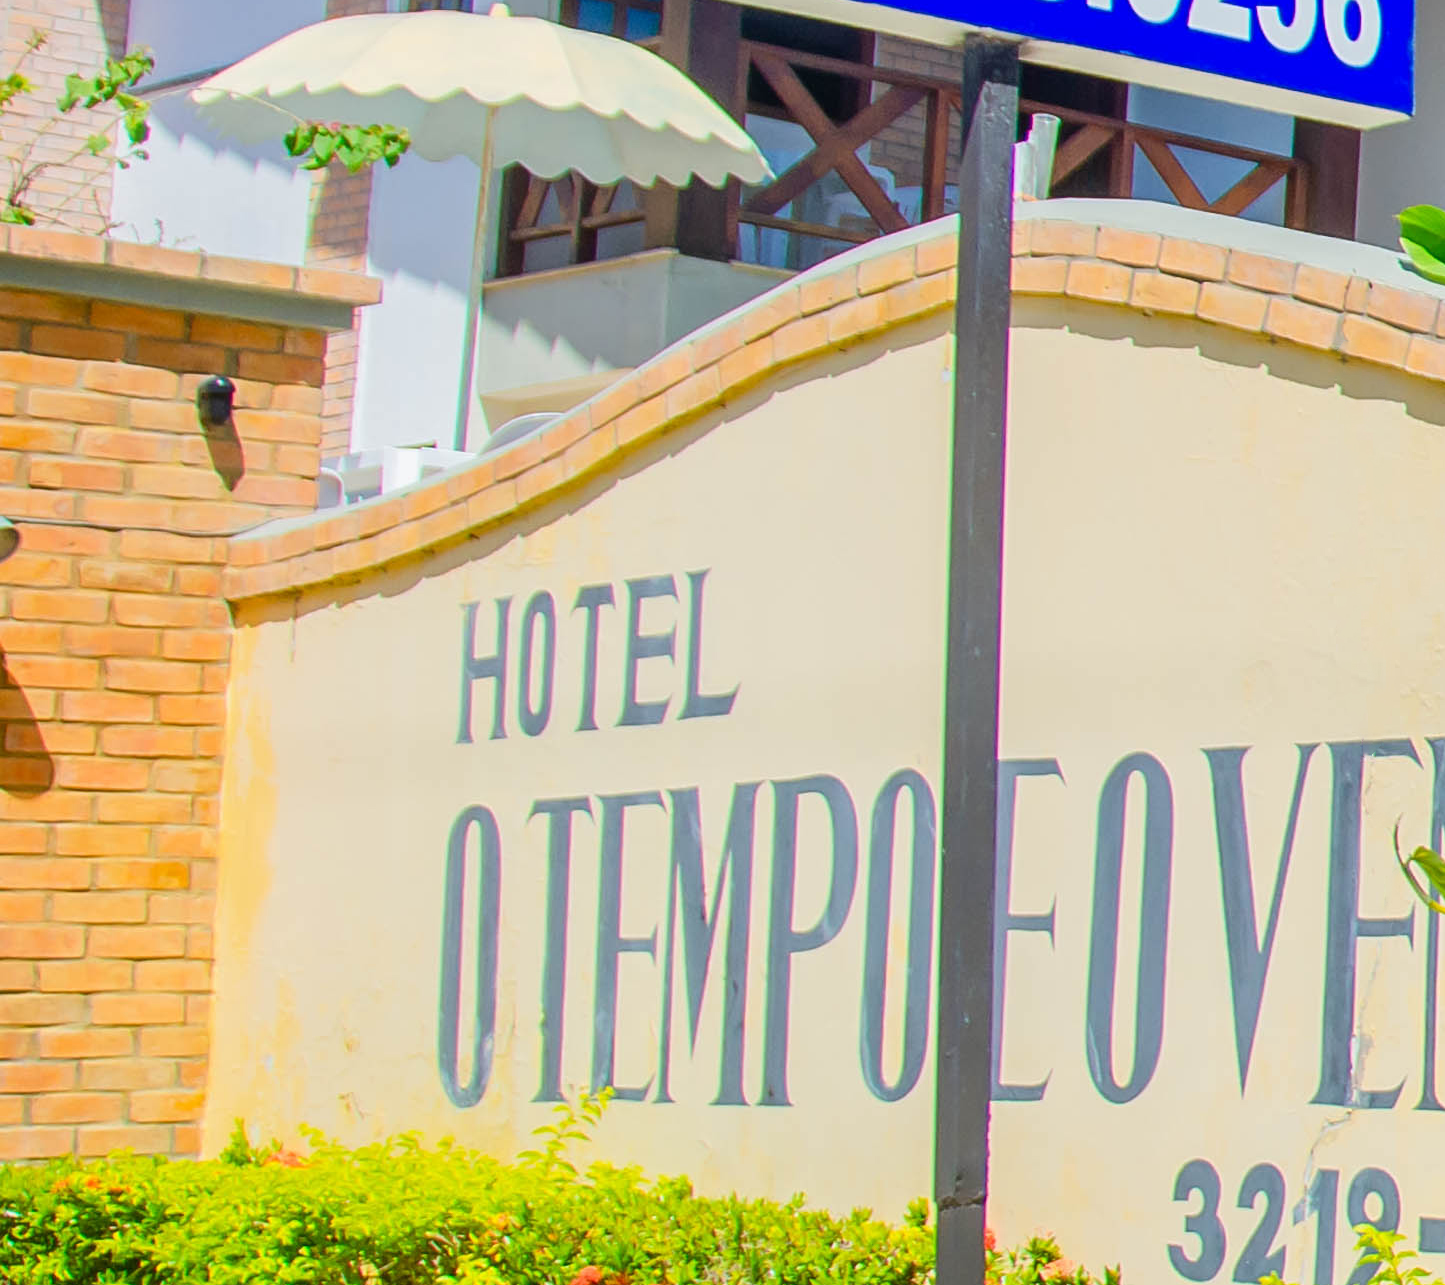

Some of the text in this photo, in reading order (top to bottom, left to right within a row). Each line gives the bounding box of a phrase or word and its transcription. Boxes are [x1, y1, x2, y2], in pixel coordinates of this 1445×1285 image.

[455, 568, 740, 745] HOTEL
[437, 804, 501, 1109] O
[526, 768, 936, 1108] TEMPO
[1084, 751, 1174, 1105] O
